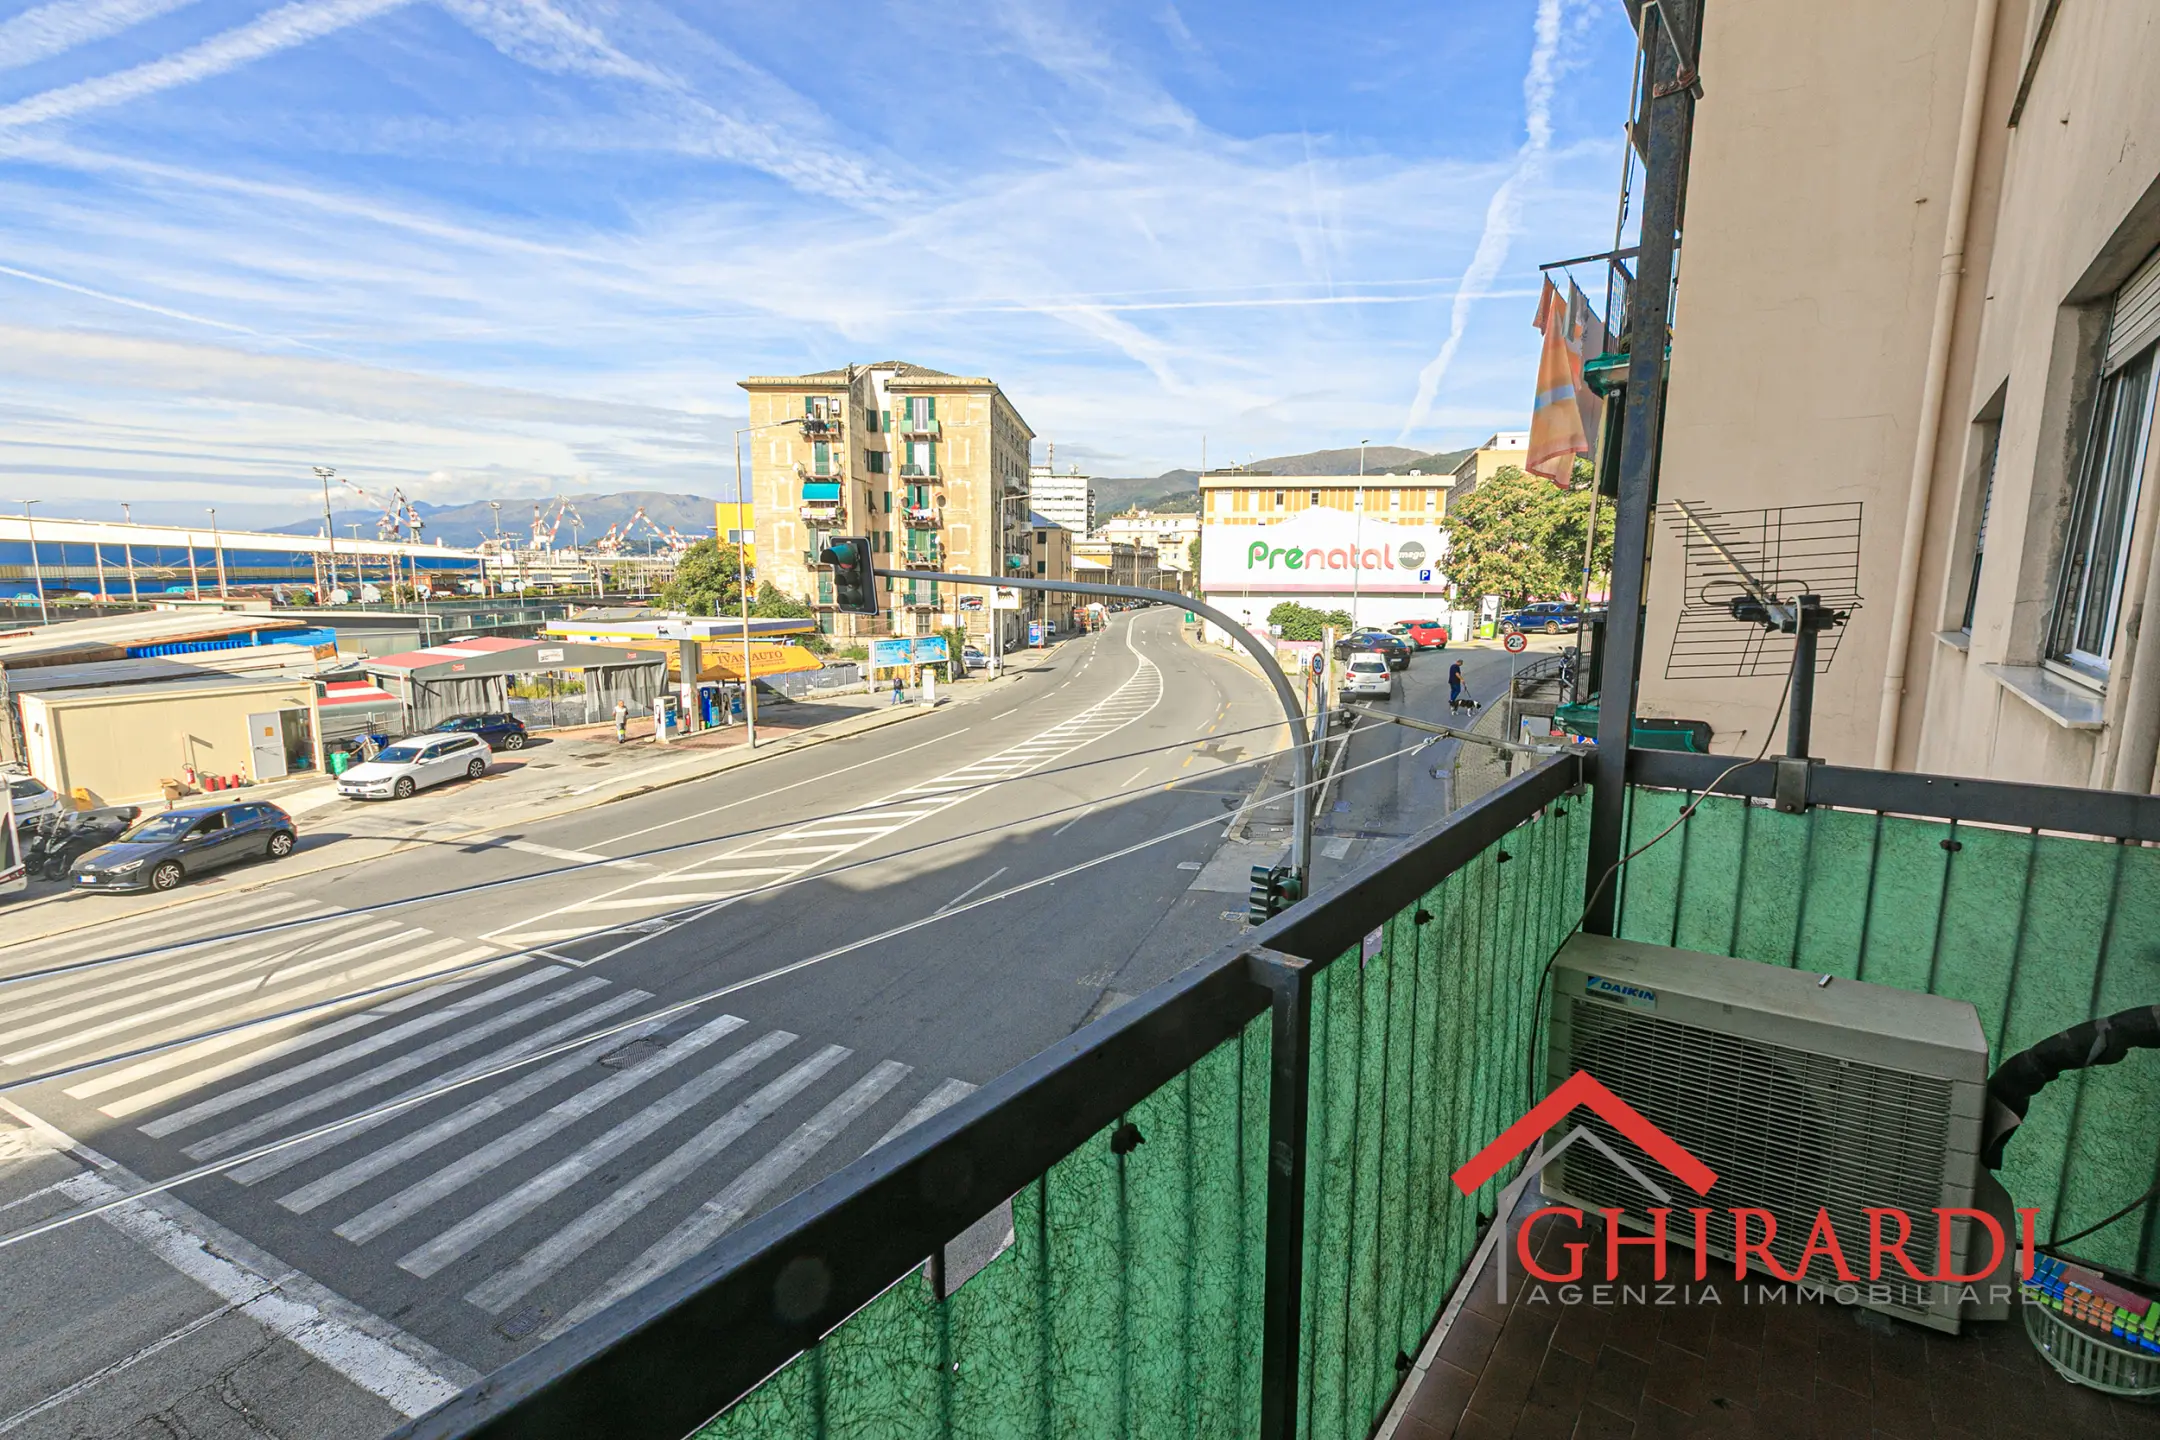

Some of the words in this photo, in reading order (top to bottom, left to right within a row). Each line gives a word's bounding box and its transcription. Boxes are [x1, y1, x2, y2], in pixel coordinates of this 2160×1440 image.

[1421, 570, 1429, 580] P
[751, 651, 783, 661] AUTO
[1600, 981, 1655, 1001] DAIKIN
